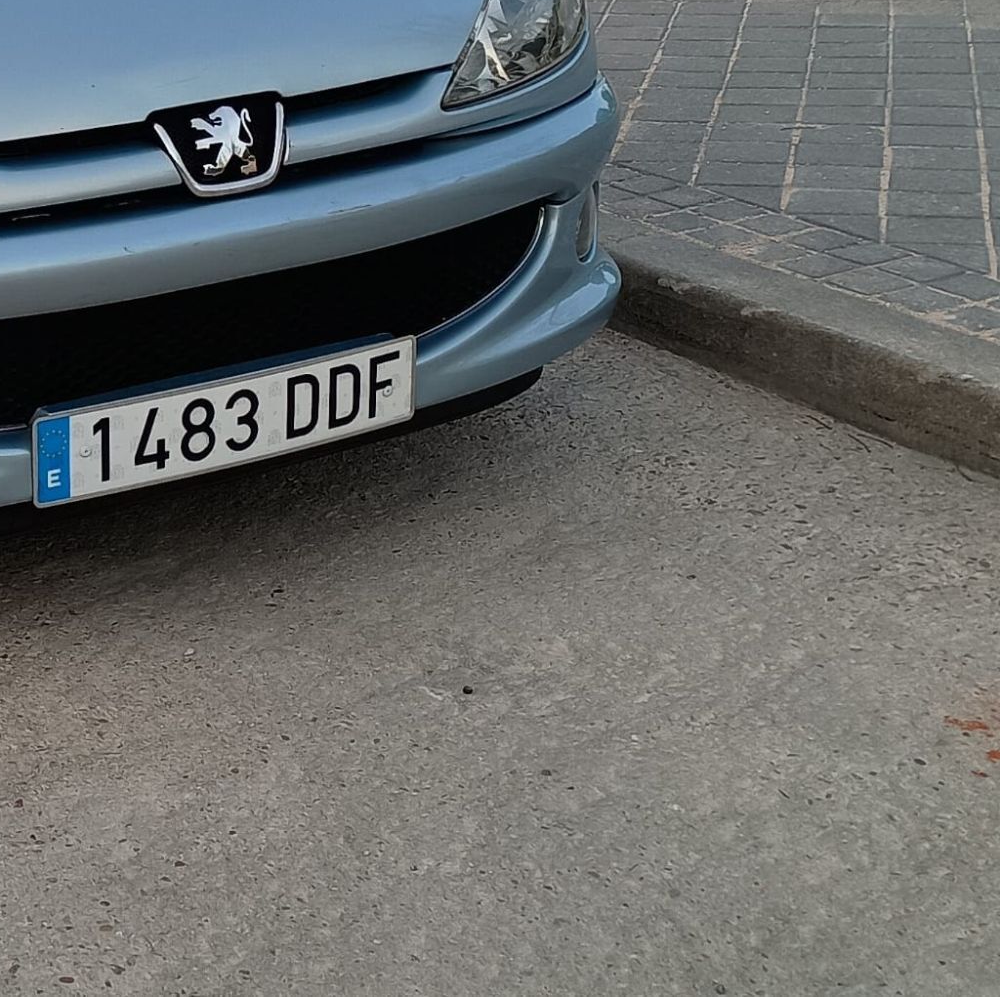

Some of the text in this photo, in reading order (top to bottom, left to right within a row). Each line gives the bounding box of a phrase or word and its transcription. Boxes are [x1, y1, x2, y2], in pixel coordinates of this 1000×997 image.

[92, 350, 401, 482] 1483 DDF
[47, 468, 62, 488] E
